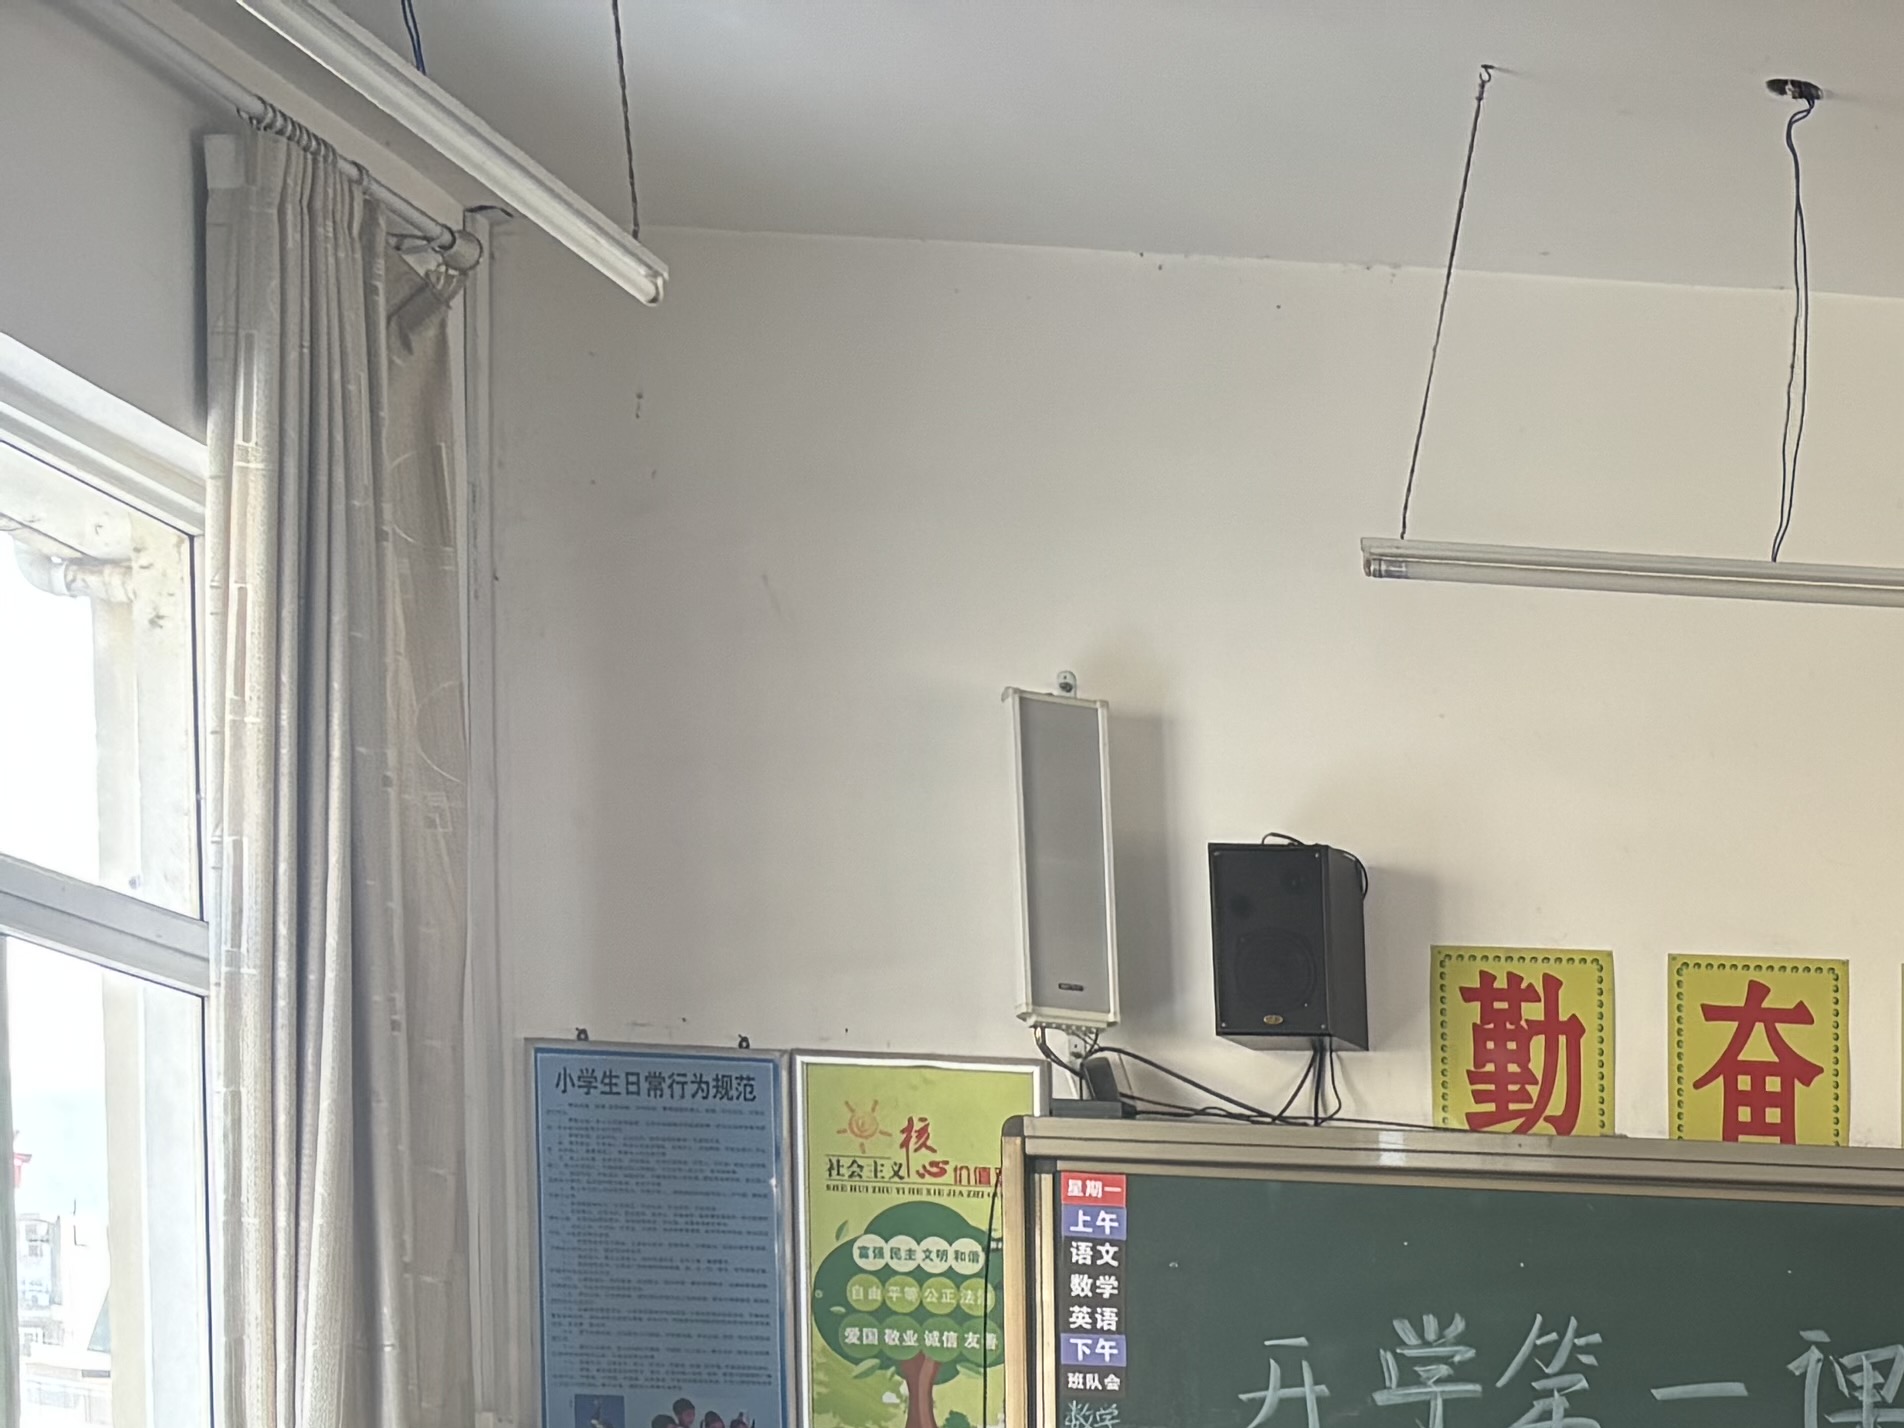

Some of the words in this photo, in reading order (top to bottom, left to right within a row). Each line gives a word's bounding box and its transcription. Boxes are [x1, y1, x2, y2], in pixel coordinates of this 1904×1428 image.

[555, 1066, 757, 1102] 小学生日常行为规范
[826, 1157, 905, 1180] 社会主义
[1067, 1178, 1122, 1199] 星期一
[1069, 1210, 1119, 1235] 上午
[1069, 1241, 1119, 1267] 语文
[1069, 1273, 1119, 1299] 数学
[1069, 1304, 1119, 1331] 英语
[1069, 1337, 1119, 1362] 下午
[1067, 1372, 1121, 1391] 班队会
